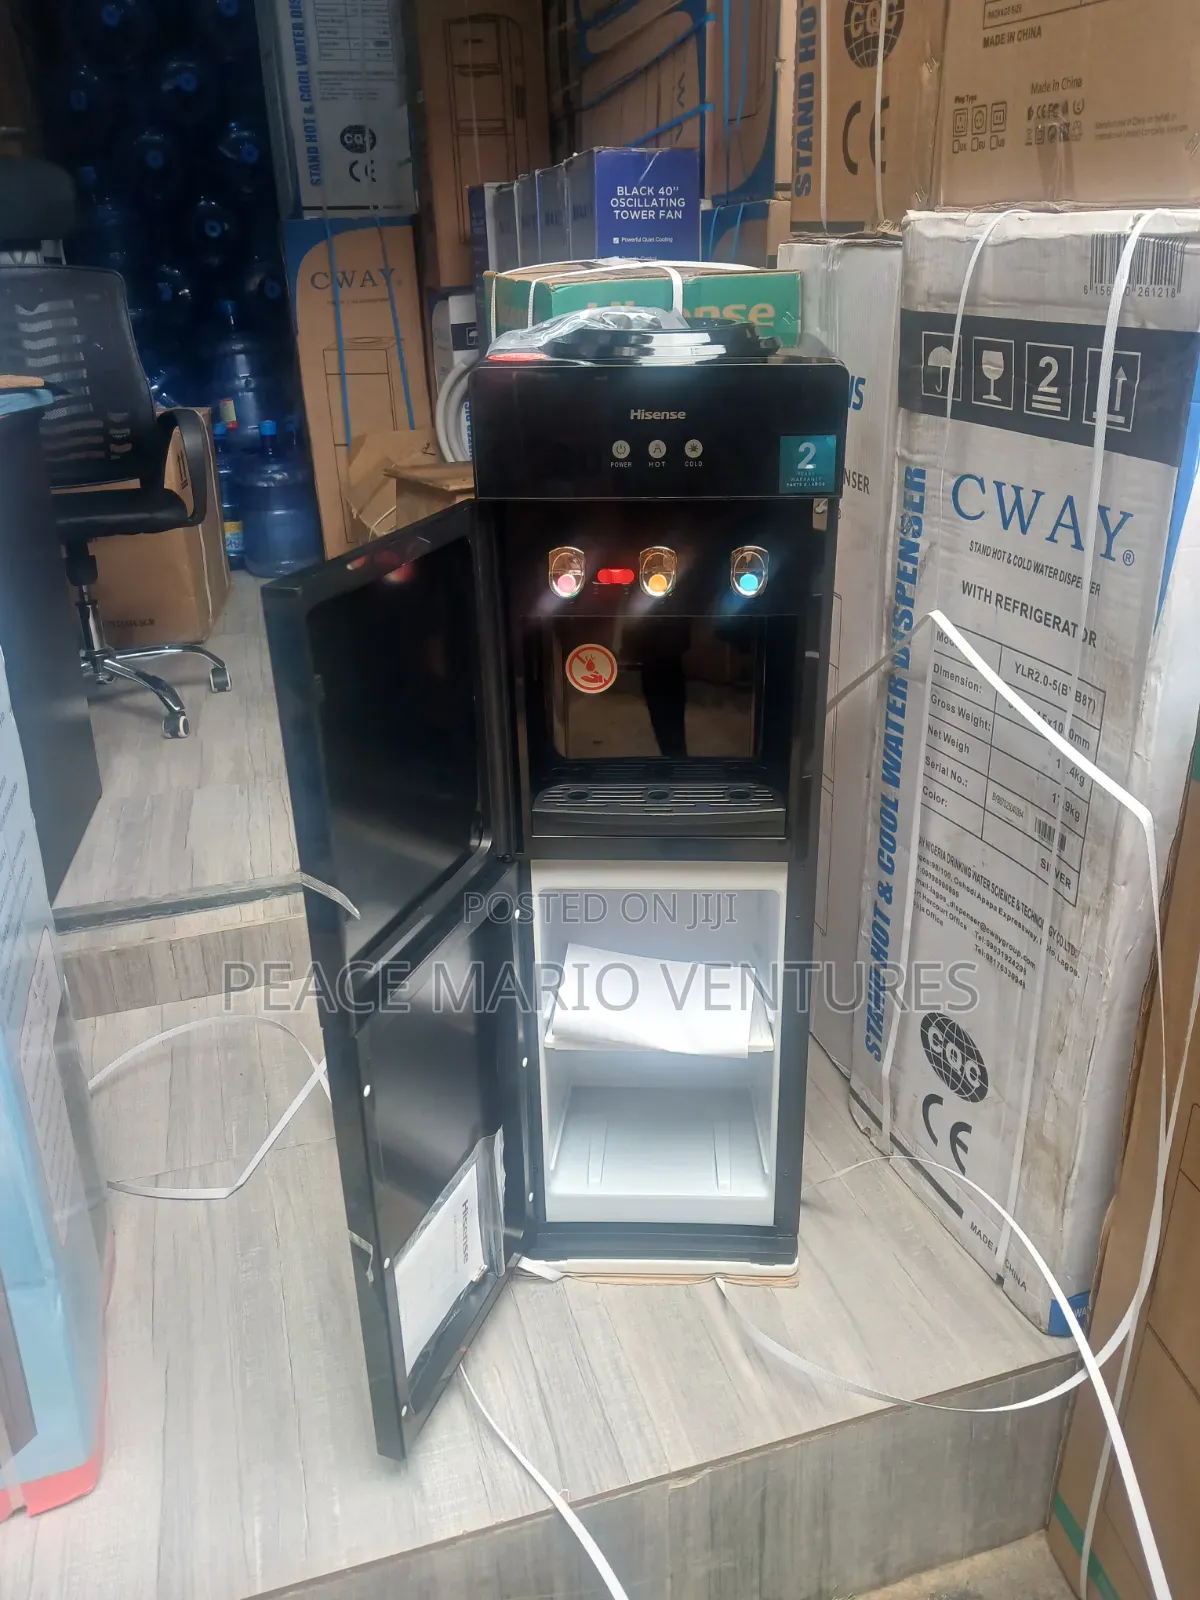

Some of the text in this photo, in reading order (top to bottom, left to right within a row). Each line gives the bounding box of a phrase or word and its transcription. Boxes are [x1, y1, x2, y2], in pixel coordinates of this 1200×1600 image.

[850, 0, 899, 39] CQC
[983, 26, 1042, 49] MADE IN CHINA
[795, 0, 817, 197] STAND HO
[1031, 76, 1083, 95] Made in China
[303, 117, 318, 143] HOT
[306, 146, 322, 187] STAND
[610, 198, 686, 208] OSCILLATING
[617, 186, 655, 196] BLACK
[613, 210, 683, 220] TOWER FAN
[656, 236, 674, 244] Cooling
[310, 268, 395, 290] CWAY
[1137, 286, 1177, 298] 261218
[1038, 355, 1059, 392] 2
[630, 409, 687, 420] Hisense
[684, 460, 703, 468] COLD
[797, 441, 817, 469] 2
[952, 473, 1134, 562] CWAY
[969, 540, 1101, 597] STAND HOT & COLD WATER DISPEER
[961, 580, 993, 605] WITH
[933, 663, 983, 694] Dimension:
[930, 693, 956, 714] Gross
[957, 706, 992, 732] Weight:
[881, 675, 909, 791] WATER
[927, 723, 970, 754] Net Weigh
[925, 756, 968, 788] Serial No.:
[1056, 758, 1085, 787] 1.4kg
[922, 785, 948, 808] Color:
[877, 790, 899, 877] COOL
[926, 839, 946, 862] NIGERIA
[947, 852, 972, 879] DRINKING
[972, 869, 991, 892] WATER
[990, 882, 1016, 908] SCIENCE
[1040, 858, 1072, 891] SIVER
[877, 880, 894, 906] &
[953, 876, 977, 897] Oshodi
[977, 892, 998, 912] Apapa
[922, 893, 949, 917] Harcourt
[949, 912, 968, 931] Office
[925, 908, 944, 926] Office
[870, 902, 892, 970] HOT
[927, 1026, 982, 1088] CQC
[922, 1093, 972, 1176] CE
[461, 1199, 470, 1265] Hisense
[970, 1221, 993, 1251] MADE
[1004, 1258, 1028, 1292] CHINA
